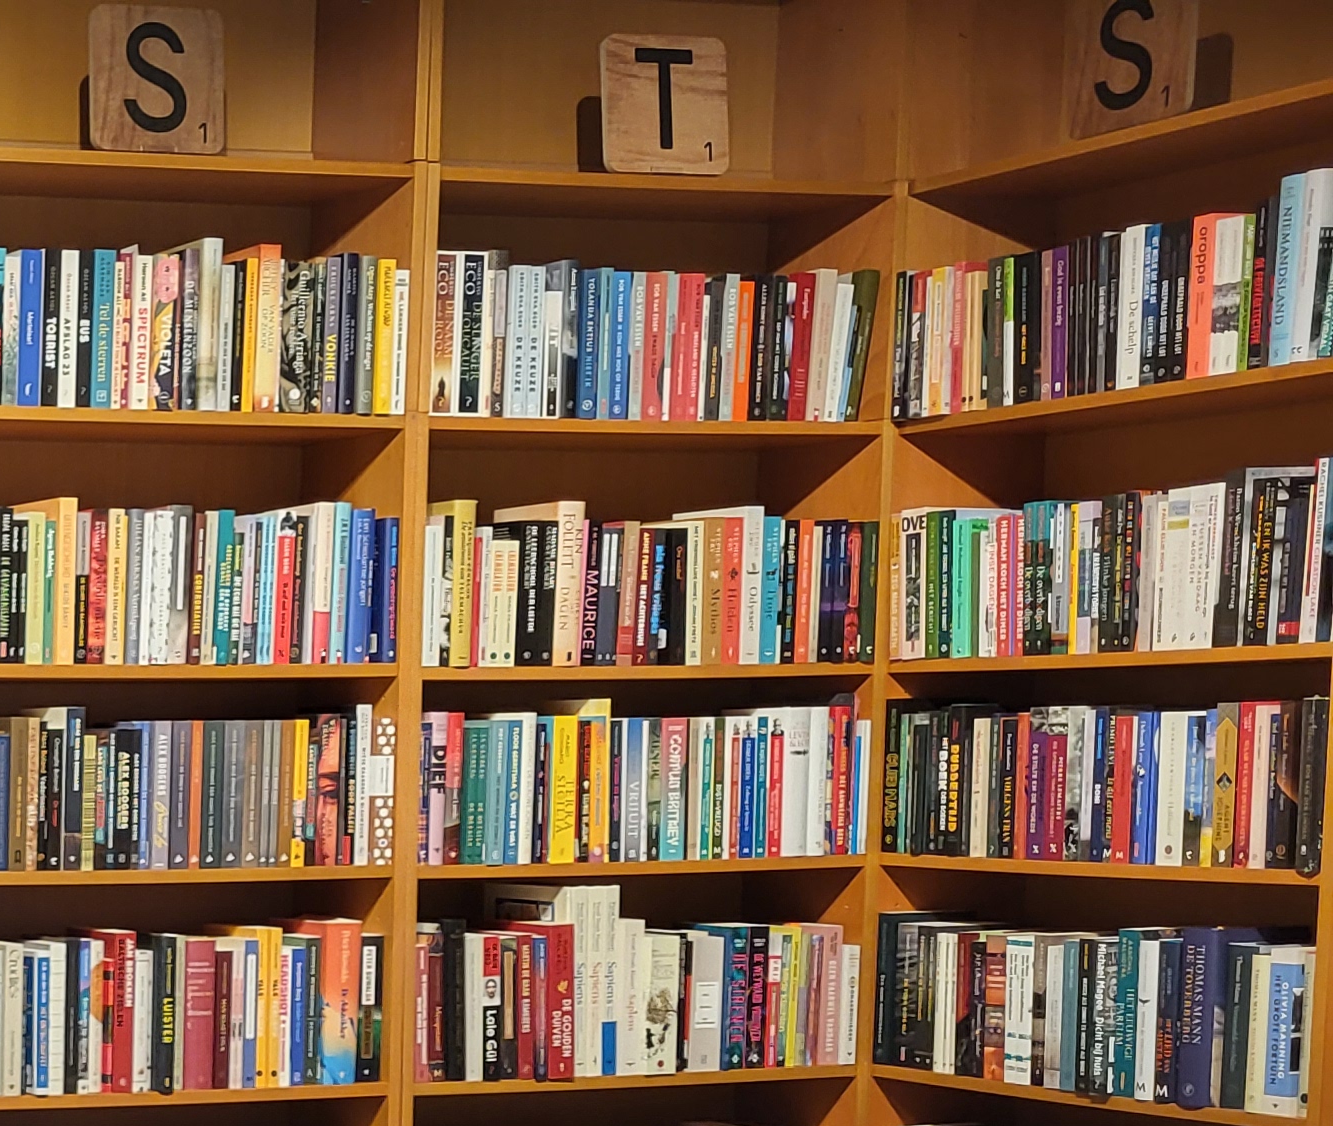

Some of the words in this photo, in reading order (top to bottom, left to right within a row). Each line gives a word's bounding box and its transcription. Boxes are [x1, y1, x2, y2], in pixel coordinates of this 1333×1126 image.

[1090, 0, 1153, 112] S
[123, 22, 188, 133] S
[1159, 85, 1173, 110] 1
[633, 47, 694, 151] T
[196, 121, 210, 146] 1
[702, 140, 716, 164] 1
[1195, 226, 1208, 284] oroppa
[1274, 205, 1293, 326] NIEMANDSLAND
[437, 261, 449, 295] ECO
[464, 262, 477, 295] ECO
[98, 303, 110, 321] Tel
[296, 270, 311, 329] Guillermo
[1128, 301, 1138, 317] De
[45, 317, 57, 369] TOERIST
[62, 318, 71, 360] AFSLAG
[136, 308, 148, 384] SPECTRUM
[158, 314, 173, 376] VIOLETA
[293, 332, 308, 374] Arriaga
[324, 334, 337, 382] VONKIE
[1126, 320, 1138, 354] schelp
[97, 340, 108, 382] sterren
[528, 357, 537, 393] KEUZE
[582, 570, 599, 650] MAURICE
[1097, 944, 1107, 978] Michael
[1194, 945, 1206, 1001] THOMAS
[124, 960, 135, 1007] BROKKEN
[574, 962, 586, 1006] Sapiens
[589, 962, 602, 1004] Sapiens
[604, 961, 617, 1004] Sapiens
[1280, 982, 1289, 1019] OLIVIA
[162, 997, 174, 1043] LUISTER
[1181, 966, 1194, 1043] TOVERBERG
[1191, 1006, 1203, 1045] MANN
[552, 1010, 562, 1047] DUIVEN
[562, 1015, 572, 1058] GOUDEN
[1093, 1042, 1104, 1055] bij
[1094, 1017, 1105, 1040] Dicht
[1277, 1023, 1288, 1079] MANNING
